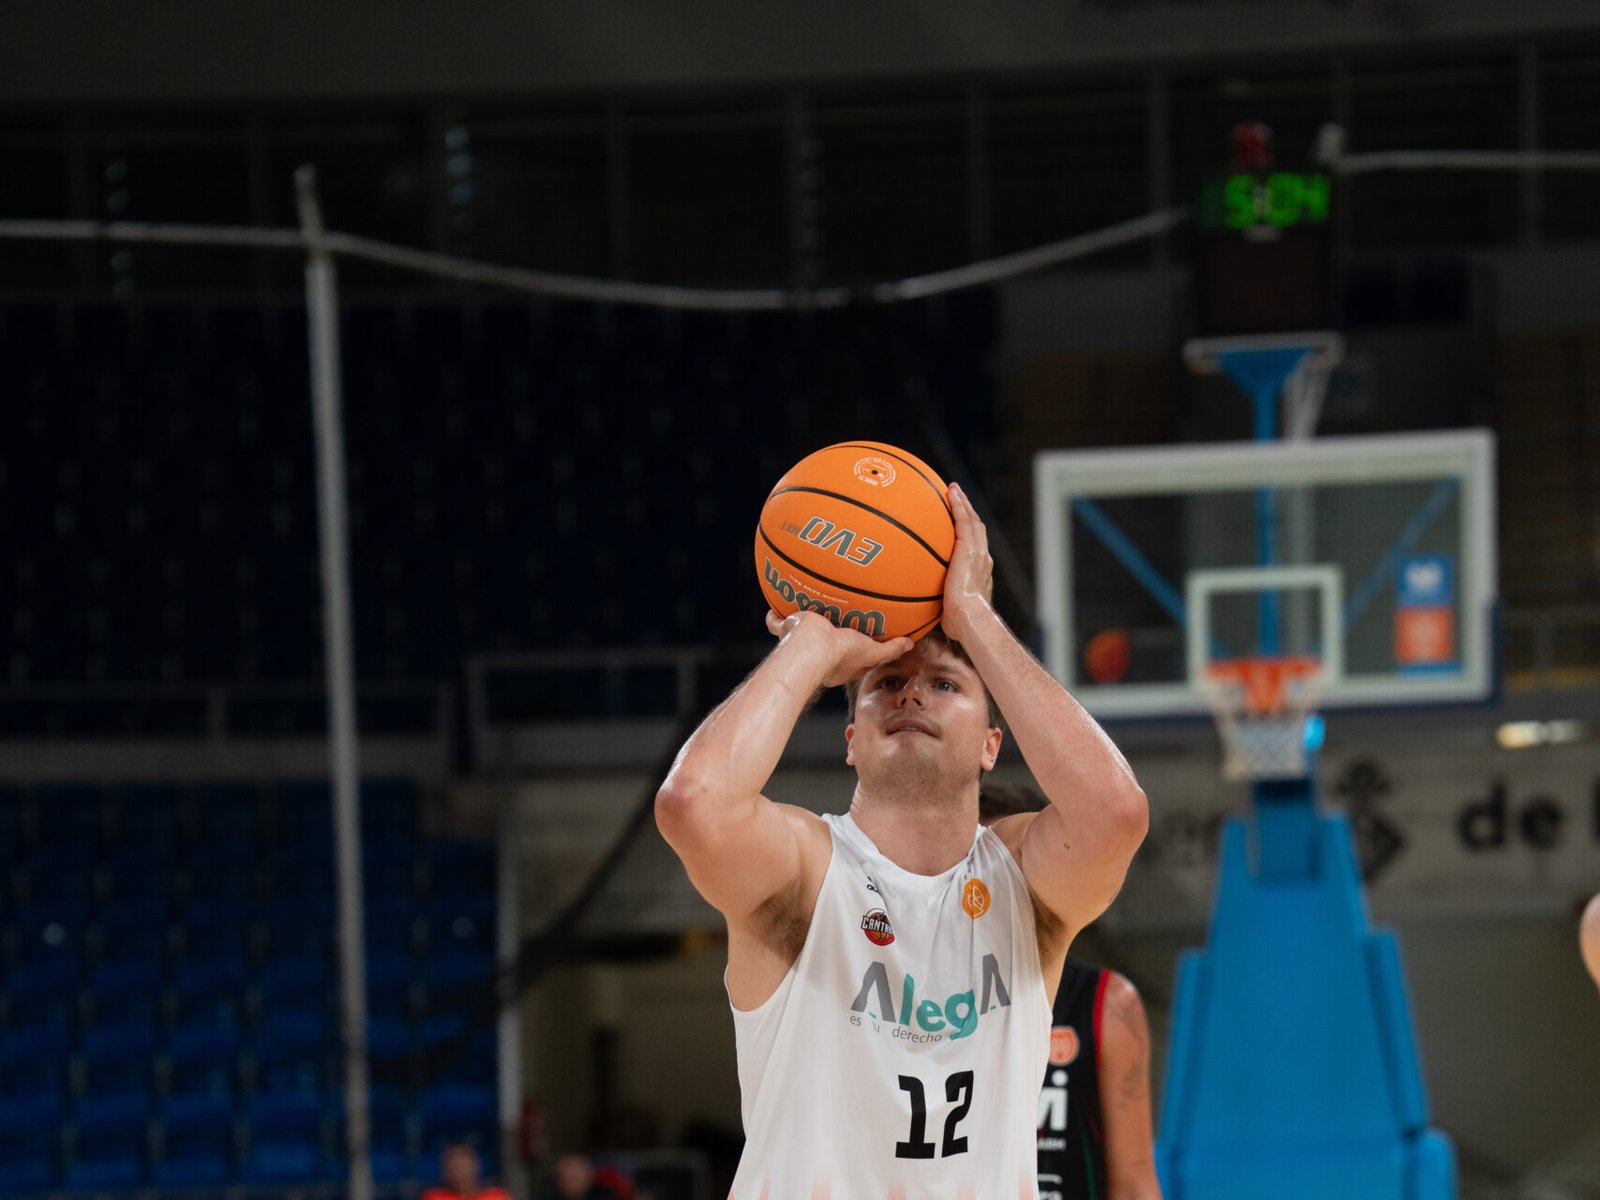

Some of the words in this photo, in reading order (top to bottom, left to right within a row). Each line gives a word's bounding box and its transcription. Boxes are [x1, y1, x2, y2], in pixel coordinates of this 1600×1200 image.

[799, 516, 884, 567] EVO
[788, 574, 803, 586] BALL
[803, 584, 821, 596] GAME
[1456, 773, 1564, 851] de
[850, 1015, 862, 1027] es
[892, 1026, 943, 1043] derecho
[895, 1070, 975, 1159] 12
